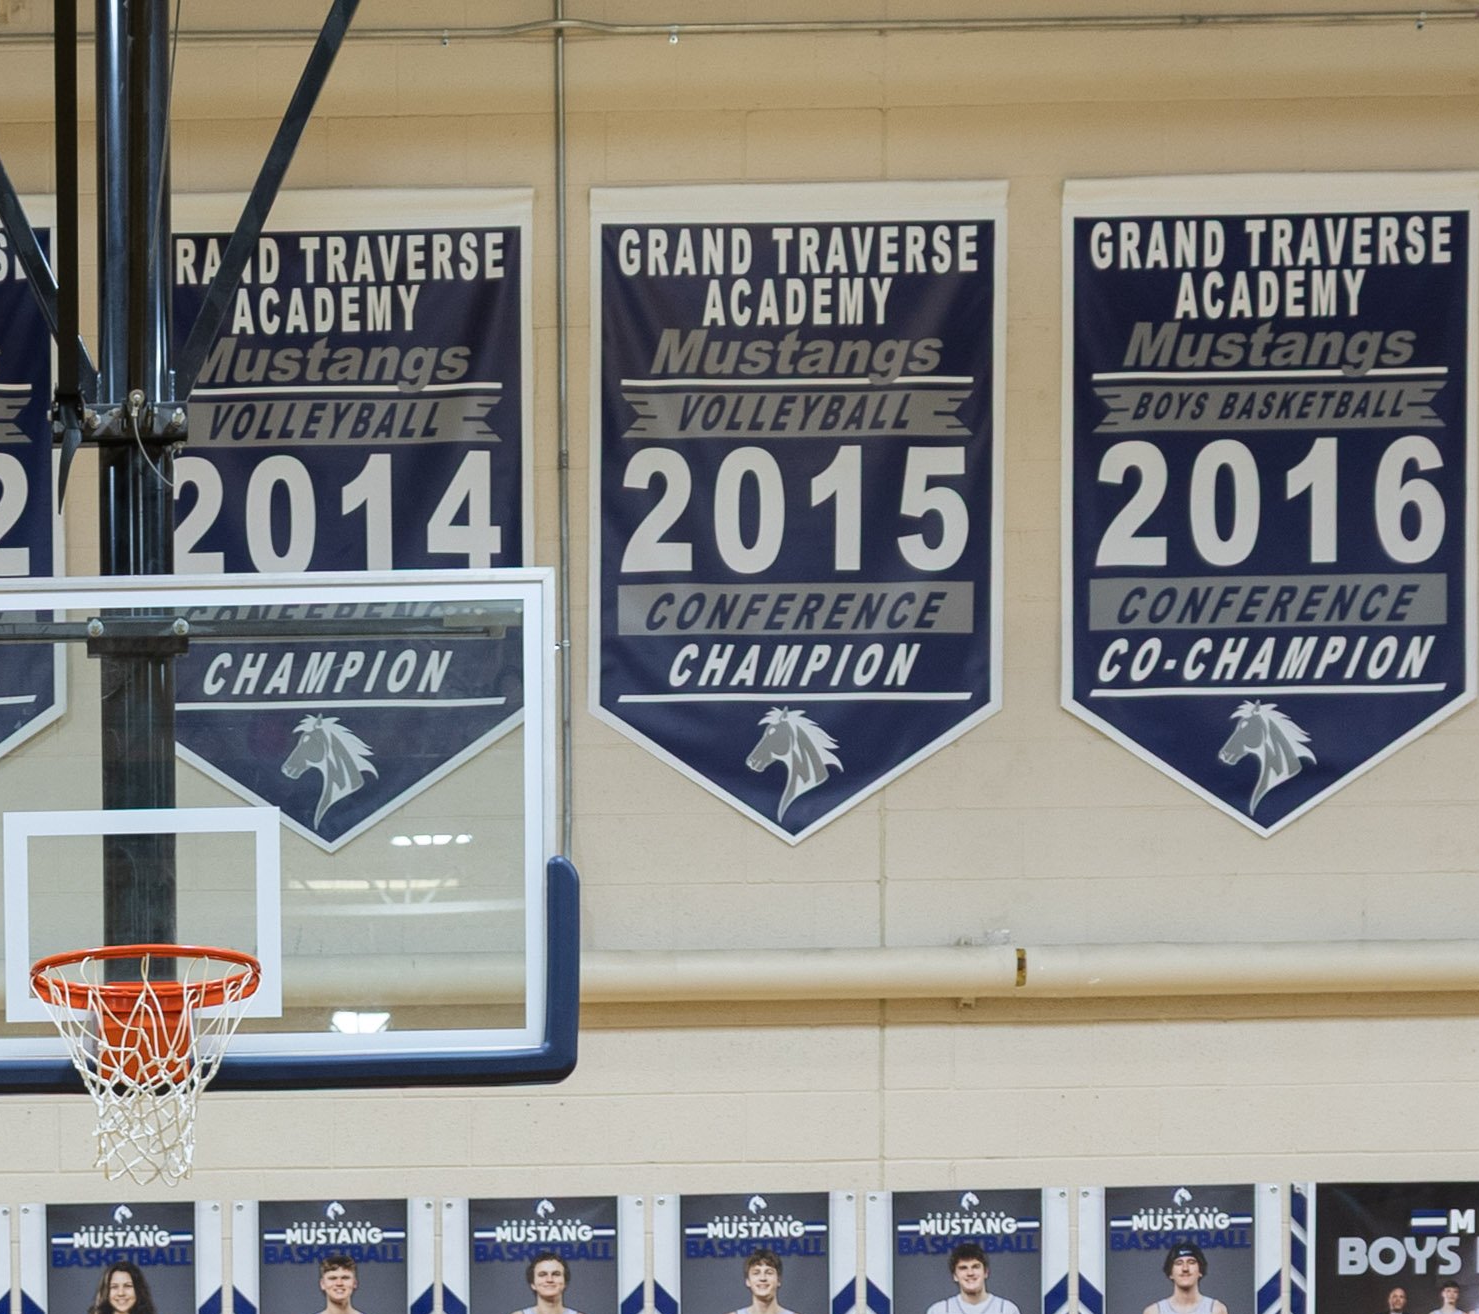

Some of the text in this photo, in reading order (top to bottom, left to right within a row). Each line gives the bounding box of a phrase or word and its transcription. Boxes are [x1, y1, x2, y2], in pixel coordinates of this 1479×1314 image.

[176, 232, 506, 285] RAD TRAVERSE
[618, 224, 979, 277] GRAND TRAVERSE
[1091, 215, 1452, 270] GRAND TRAVERSE
[231, 284, 420, 335] ACADEMY
[702, 277, 892, 327] ACADEMY
[1174, 268, 1365, 319] ACADEMY
[652, 326, 941, 384] Mustangs
[1124, 318, 1416, 376] Mustangs
[209, 401, 441, 441] VOLLEYBALL
[676, 393, 912, 433] VOLLEYBALL
[1132, 388, 1406, 422] BOYS BASKETBALL
[172, 450, 502, 572] 2014
[621, 444, 970, 573] 2015
[1096, 435, 1446, 567] 2016
[645, 590, 947, 633] CONFERENCE
[1116, 583, 1420, 625] CONFERENCE
[203, 650, 453, 695] CHAMPION
[668, 642, 921, 688] CHAMPION
[1097, 635, 1436, 683] CO-CHAMPION
[73, 1231, 171, 1248] MUSTANG
[286, 1226, 383, 1245] MUSTANG
[496, 1224, 593, 1243] MUSTANG
[707, 1220, 805, 1239] MUSTANG
[919, 1217, 1017, 1235] MUSTANG
[1132, 1213, 1230, 1231] MUSTANG
[1337, 1236, 1461, 1275] BOYS
